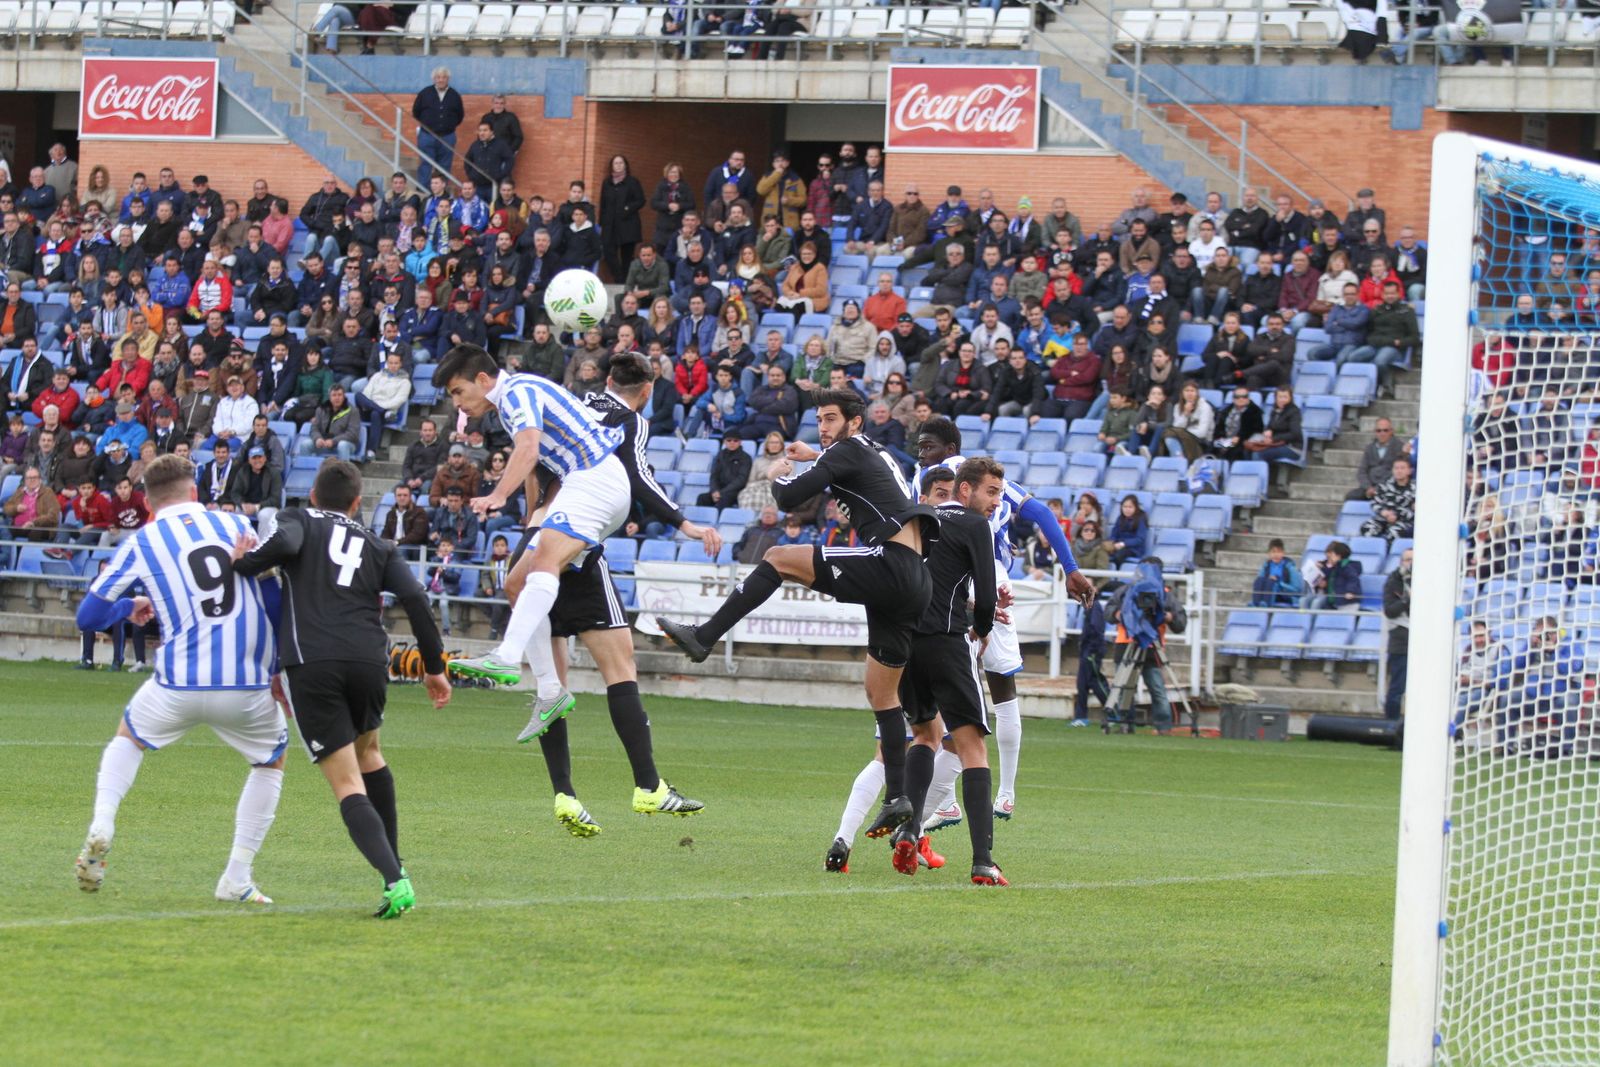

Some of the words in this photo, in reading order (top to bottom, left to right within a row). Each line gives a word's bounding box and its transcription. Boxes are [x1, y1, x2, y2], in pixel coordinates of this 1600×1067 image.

[87, 73, 209, 121] Coca-Cola
[894, 83, 1032, 132] Coca-Cola
[879, 451, 912, 499] 8
[328, 524, 365, 587] 4
[188, 545, 236, 617] 9
